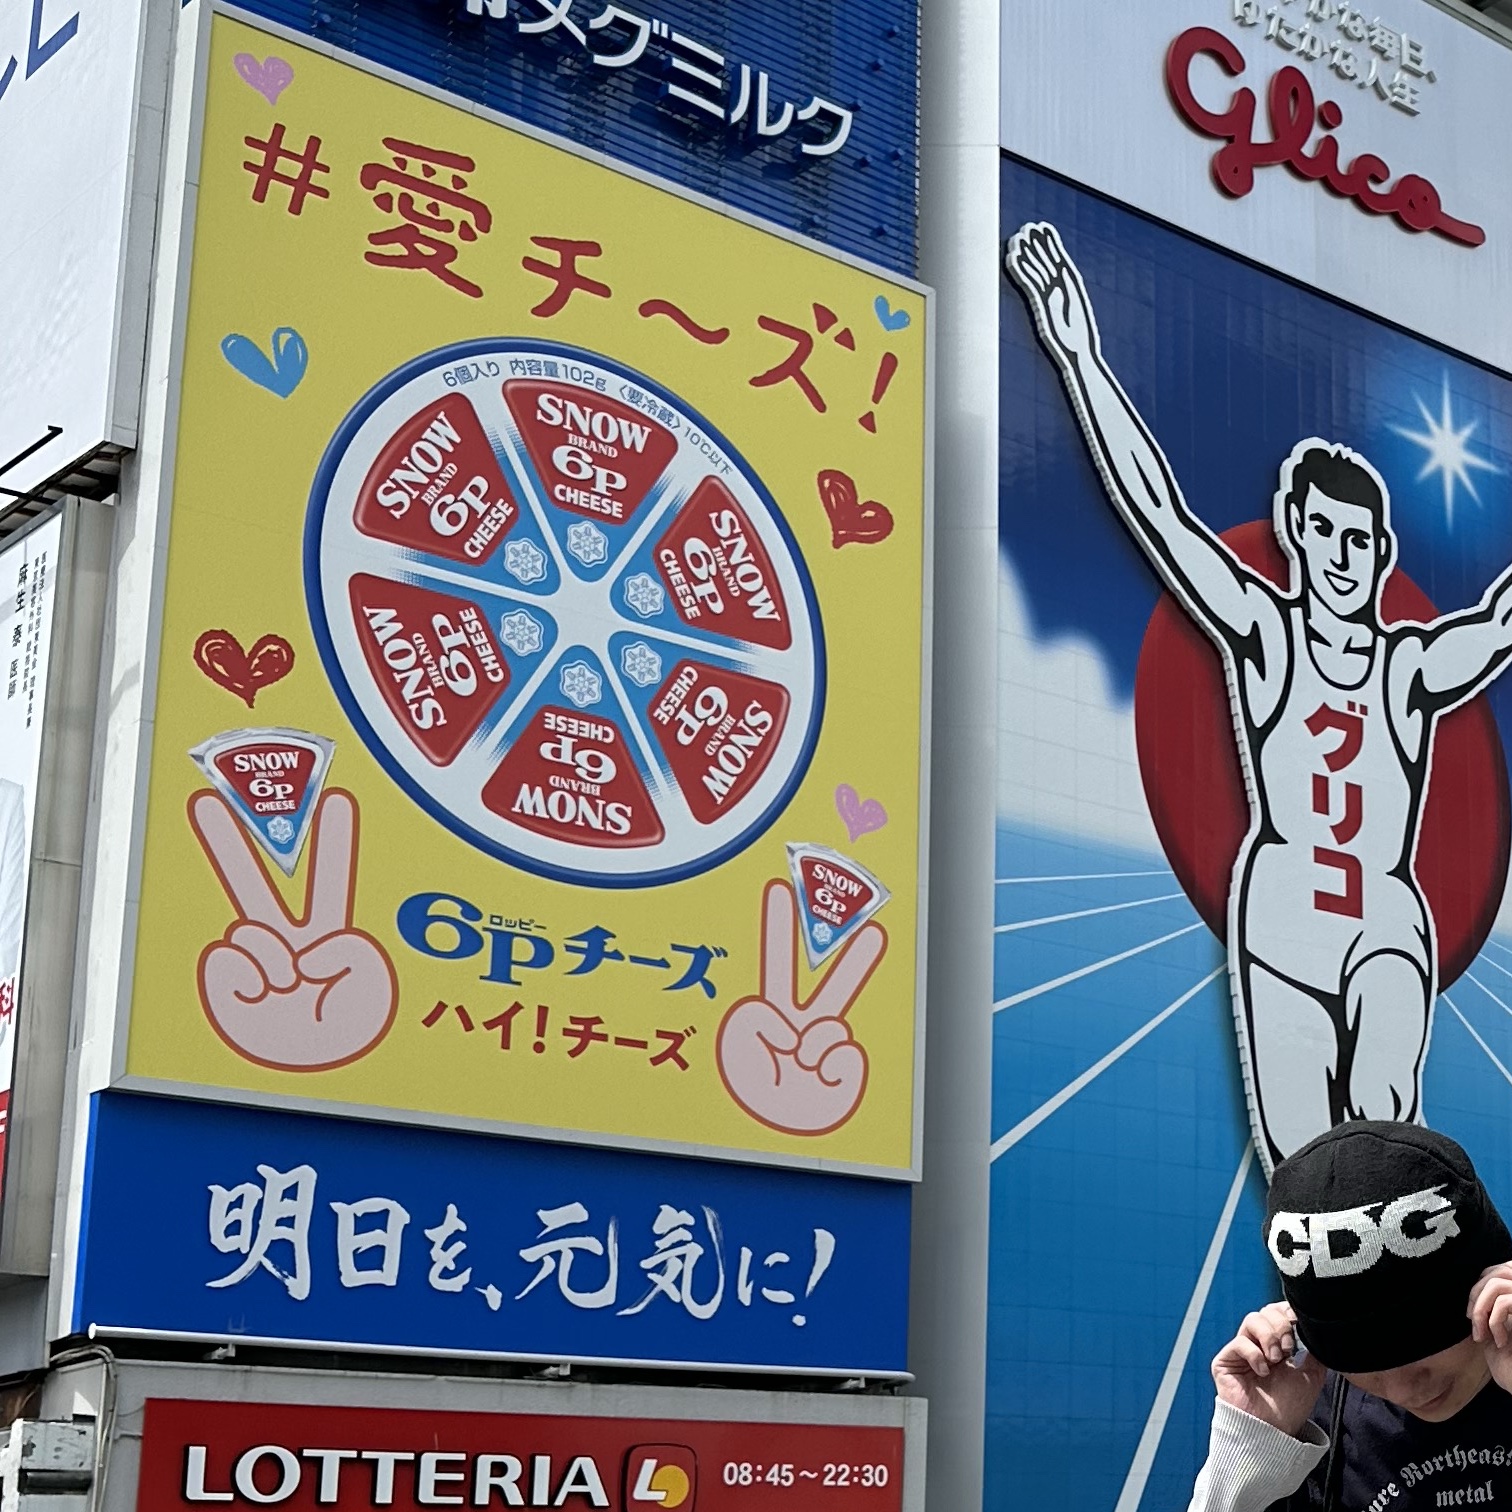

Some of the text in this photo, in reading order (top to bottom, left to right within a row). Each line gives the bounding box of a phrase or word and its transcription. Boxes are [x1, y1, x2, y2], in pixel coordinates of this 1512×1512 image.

[467, 0, 853, 155] メグミルク
[1166, 26, 1486, 248] Glico
[443, 359, 501, 387] 6個入り
[536, 393, 651, 454] SNOW
[568, 433, 618, 459] BRAND
[376, 411, 462, 520] SNOW
[421, 462, 459, 505] BRAND
[463, 498, 515, 560] CHEESE
[554, 484, 623, 520] CHEESE
[658, 548, 702, 621] CHEESE
[708, 509, 781, 623] SNOW
[712, 546, 741, 598] BRAND
[363, 605, 447, 730] SNOW
[411, 632, 445, 689] BRAND
[459, 607, 505, 684] CHEESE
[653, 666, 698, 726] CHEESE
[544, 712, 615, 744] CHEESE
[700, 700, 773, 805] SNOW
[703, 713, 735, 757] BRAND
[233, 751, 299, 772] SNOW
[549, 775, 601, 796] BRAND
[255, 800, 295, 812] CHEESE
[511, 782, 633, 835] SNOW
[1303, 700, 1369, 919] グリコ
[812, 864, 863, 897] SNOW
[1268, 1183, 1461, 1278] CDG
[186, 1446, 610, 1507] LOTTERIA
[1436, 1480, 1494, 1508] metal
